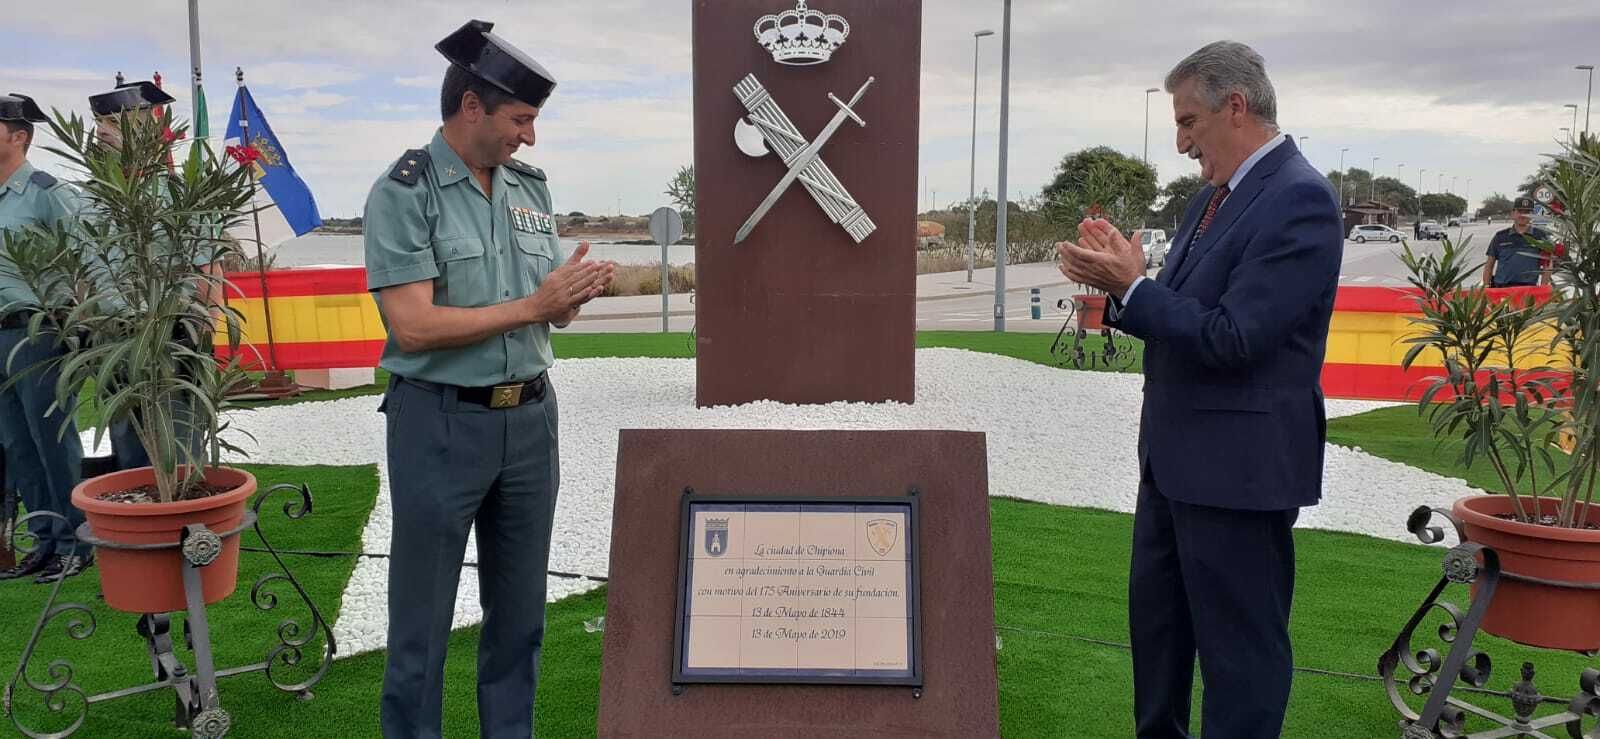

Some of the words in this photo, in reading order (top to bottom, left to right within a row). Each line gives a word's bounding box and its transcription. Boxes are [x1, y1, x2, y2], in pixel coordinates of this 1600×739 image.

[754, 544, 765, 557] La
[767, 545, 794, 555] ciudad
[796, 545, 805, 555] de
[807, 544, 845, 557] Chipiona
[724, 567, 734, 575] en
[736, 565, 797, 579] agradecimiento
[807, 566, 815, 575] la
[816, 565, 851, 576] Guardia
[854, 565, 875, 576] Civil
[698, 588, 711, 596] con
[714, 587, 743, 596] motivo
[746, 586, 757, 596] del
[760, 585, 777, 597] 175
[777, 585, 831, 597] Aniversario
[833, 587, 843, 597] de
[752, 607, 762, 617] 13
[764, 607, 773, 617] de
[809, 607, 819, 617] de
[821, 607, 846, 618] 1844
[752, 628, 762, 639] 13
[764, 629, 773, 639] de
[809, 629, 819, 639] de
[821, 628, 847, 640] 2019
